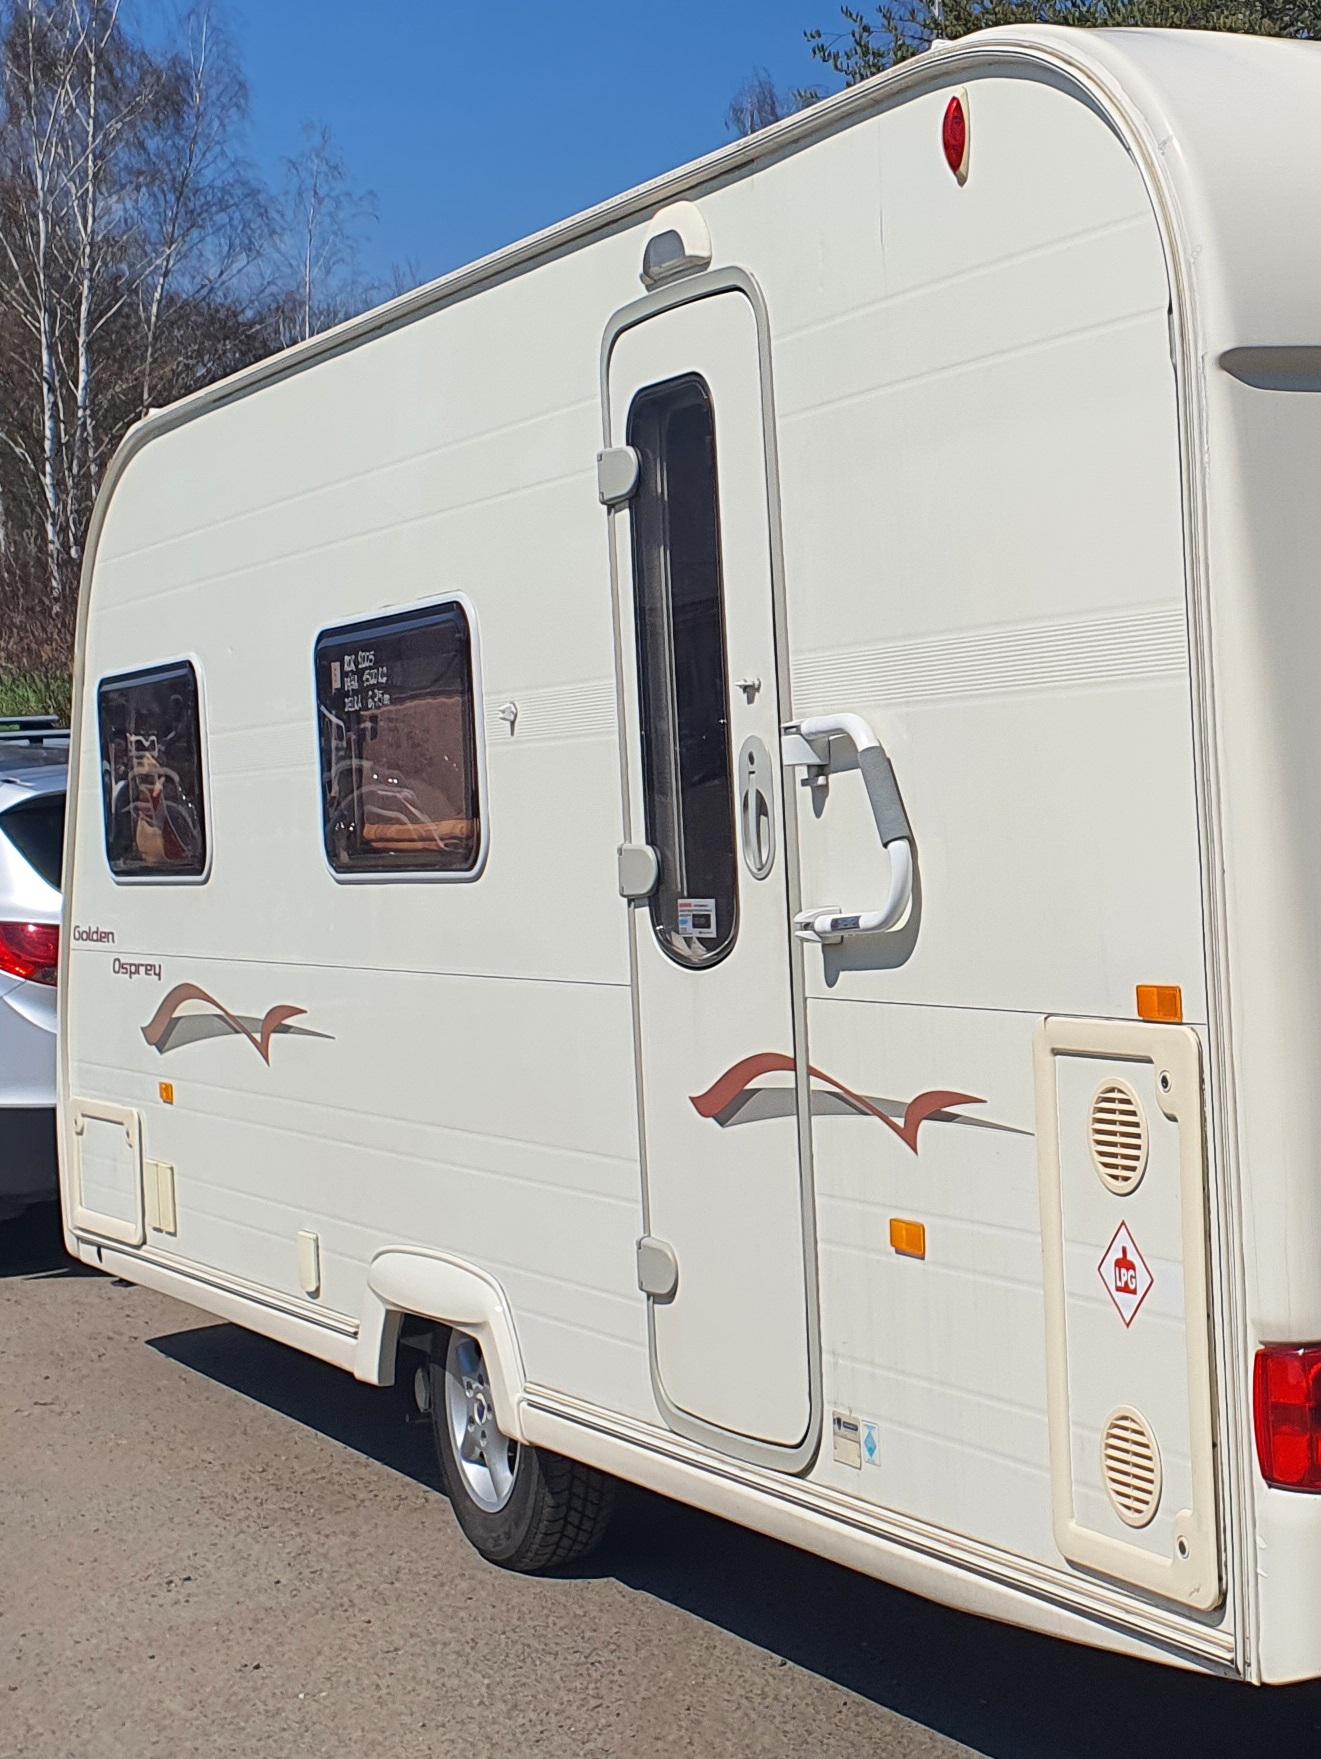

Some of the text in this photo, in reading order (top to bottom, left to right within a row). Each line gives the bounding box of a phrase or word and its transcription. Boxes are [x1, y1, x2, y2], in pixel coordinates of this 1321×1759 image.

[73, 924, 115, 944] Golden
[112, 957, 162, 981] Osprey
[1115, 1267, 1137, 1290] LPG
